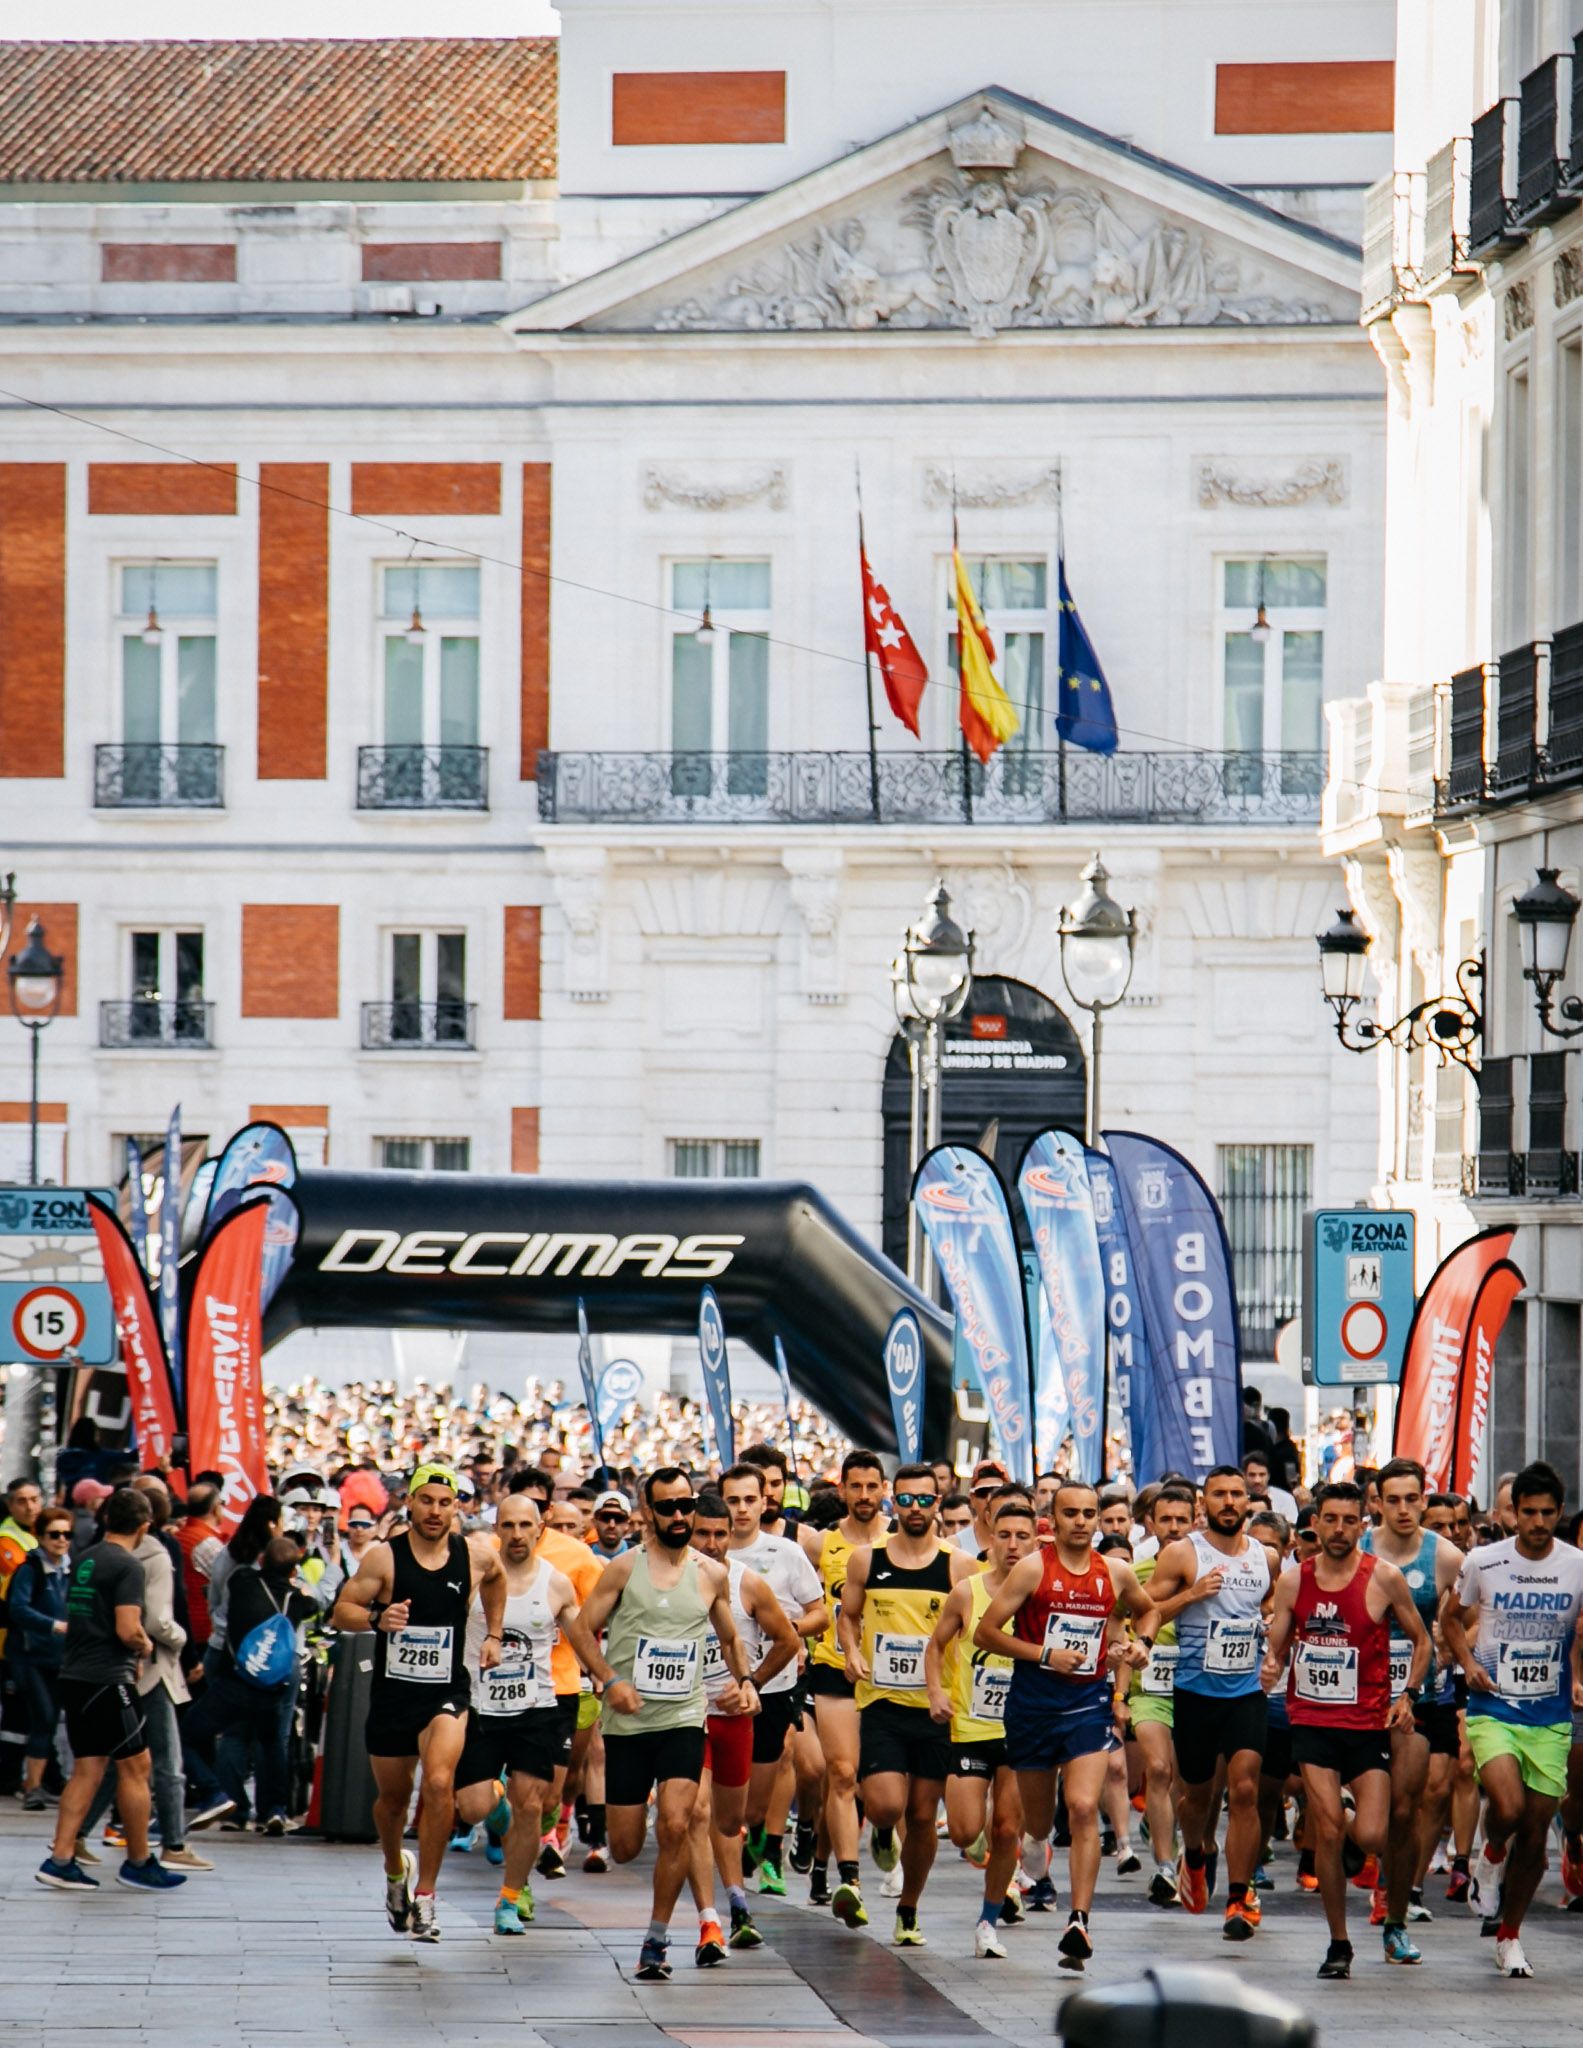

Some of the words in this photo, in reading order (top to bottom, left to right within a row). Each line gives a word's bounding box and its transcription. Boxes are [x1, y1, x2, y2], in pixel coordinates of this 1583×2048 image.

[945, 1040, 1033, 1054] PRESIDENCIA
[992, 1055, 1013, 1069] DE
[1013, 1055, 1067, 1069] MADRID
[1352, 1222, 1407, 1240] ZONA
[319, 1229, 746, 1278] DECIMAS
[1351, 1241, 1408, 1252] PEATONAL
[34, 1311, 64, 1335] 15
[1517, 1575, 1559, 1585] Sabadell
[1066, 1603, 1105, 1612] MARATHON
[1493, 1592, 1573, 1611] MADRID
[1507, 1612, 1537, 1620] CORRE
[1541, 1612, 1558, 1620] POR
[1493, 1619, 1567, 1639] MADRID
[1221, 1642, 1251, 1659] 1237
[1321, 1637, 1349, 1647] LUNES
[398, 1647, 440, 1667] 2286
[889, 1657, 918, 1675] 567
[647, 1663, 686, 1681] 1905
[1153, 1667, 1174, 1682] 22
[1308, 1668, 1340, 1687] 594
[1511, 1665, 1549, 1683] 1429
[489, 1683, 527, 1701] 2288
[984, 1690, 1009, 1707] 22
